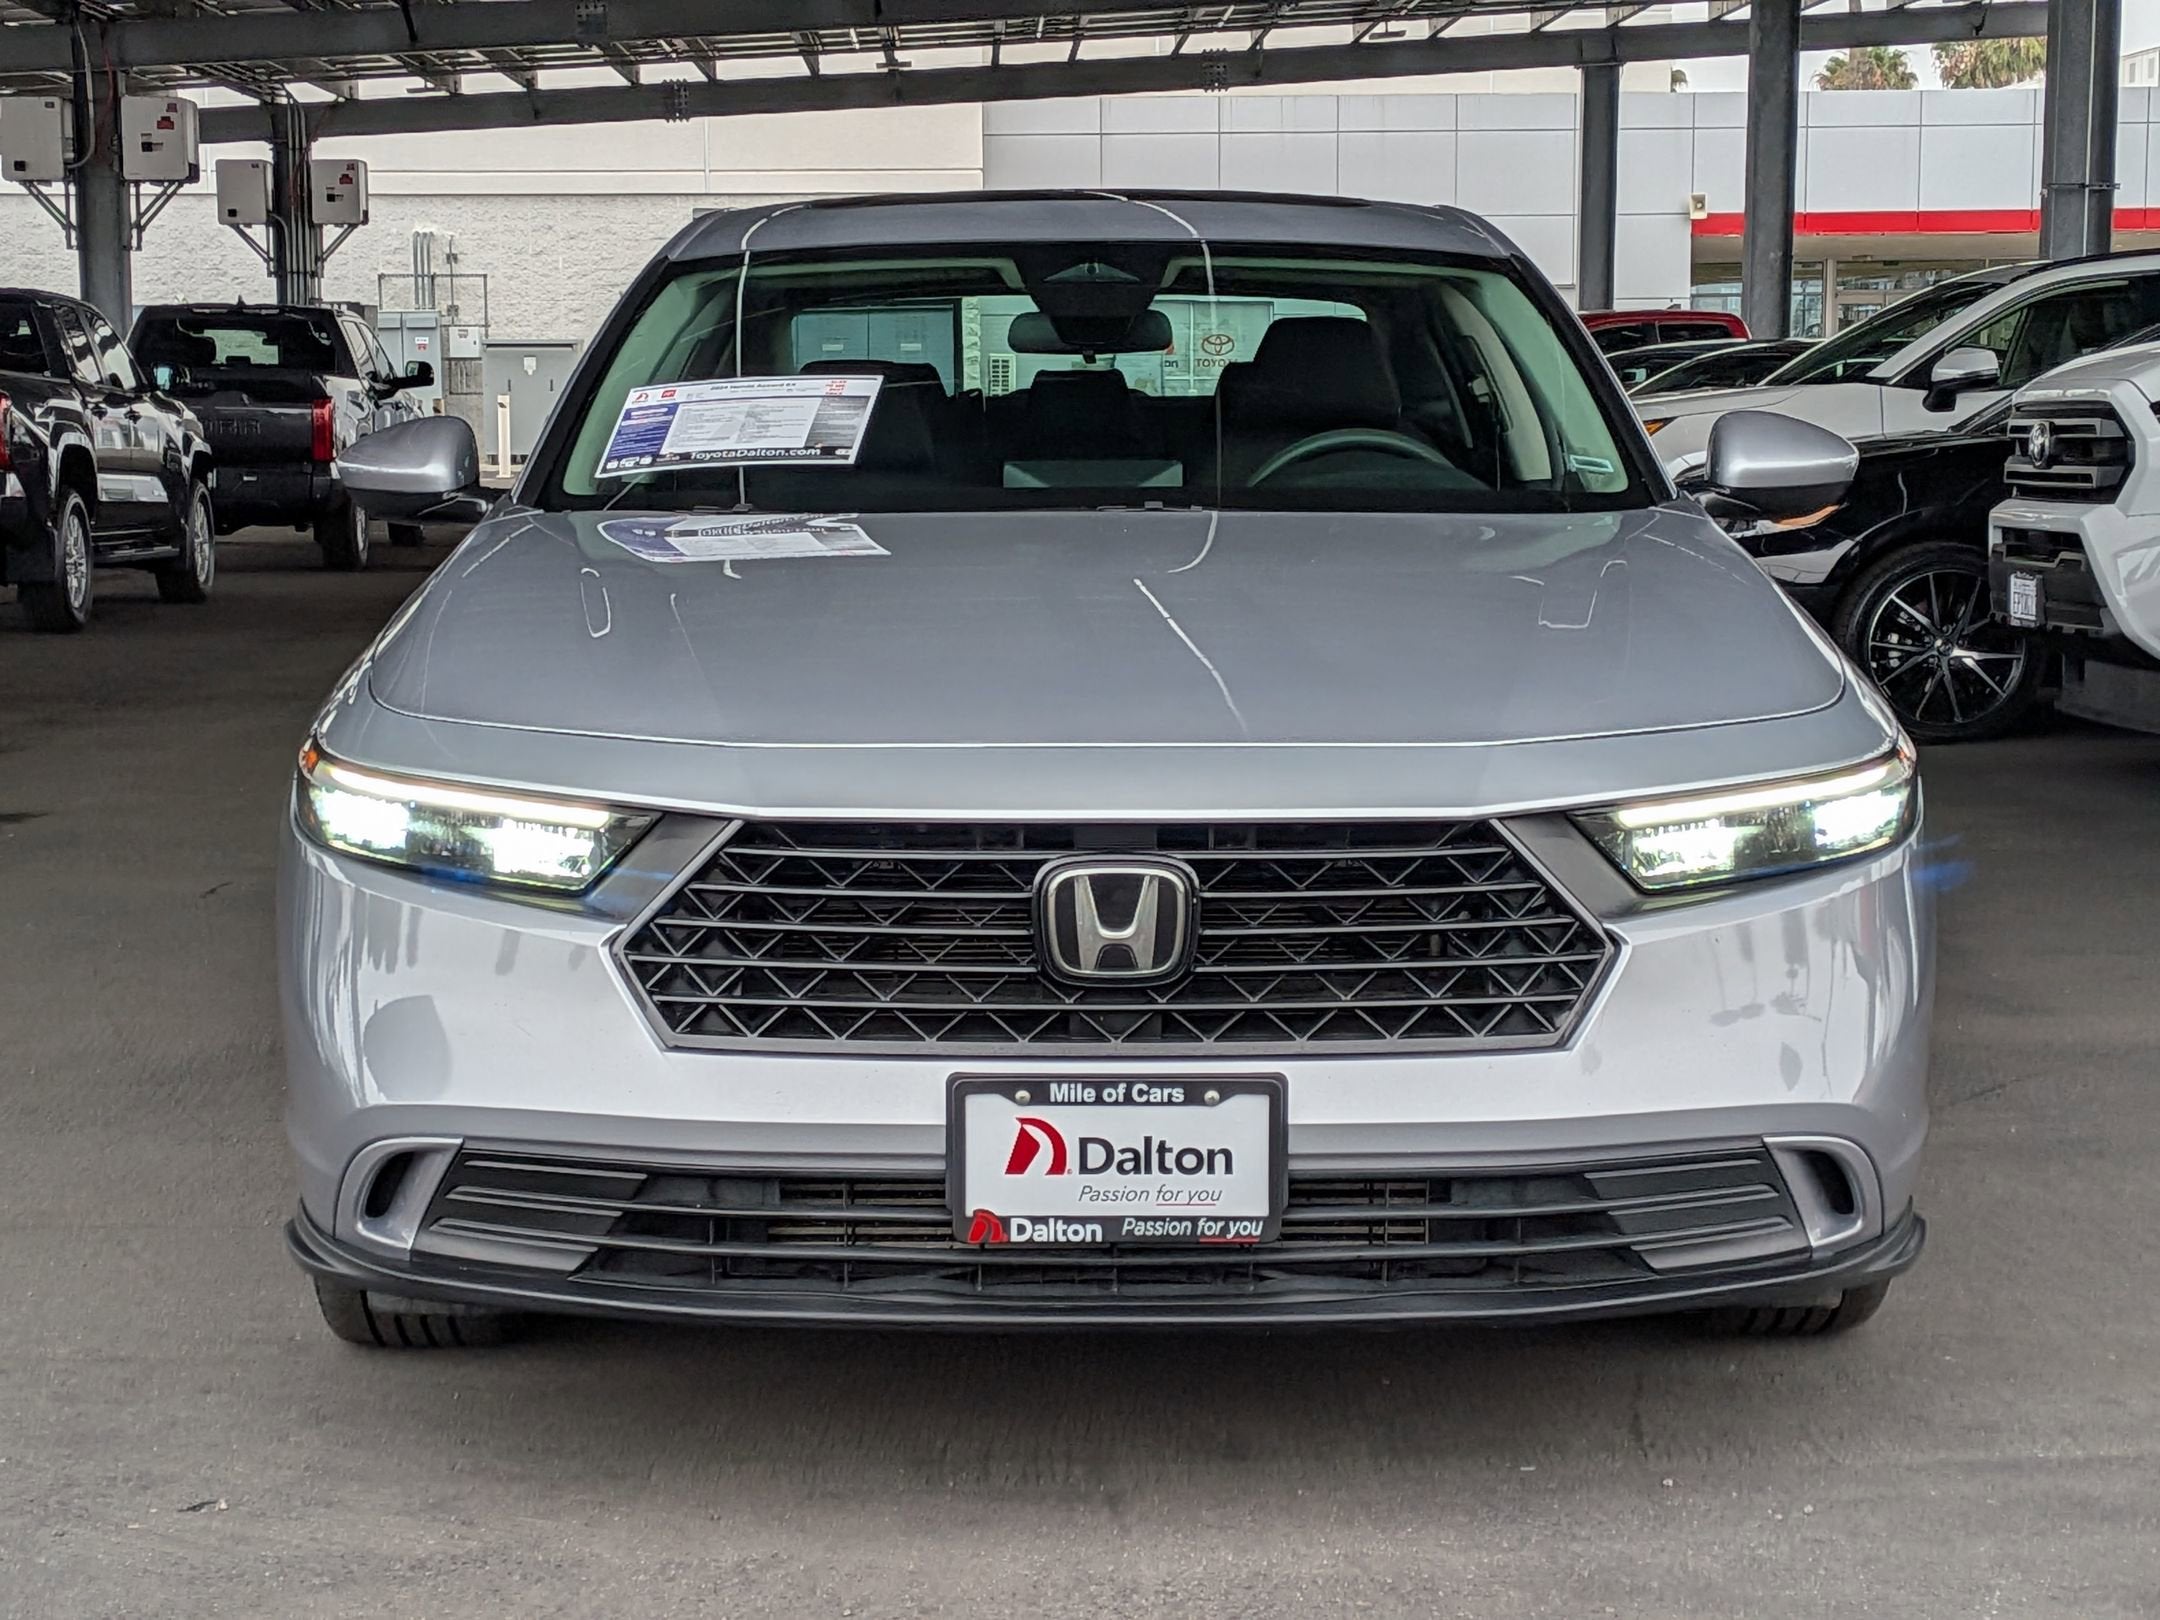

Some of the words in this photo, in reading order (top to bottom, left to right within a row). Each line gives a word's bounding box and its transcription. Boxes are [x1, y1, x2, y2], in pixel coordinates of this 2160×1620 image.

[690, 448, 821, 461] ToyotaDalton.com
[1050, 1082, 1097, 1103] Mile
[1102, 1082, 1127, 1103] of
[1131, 1082, 1185, 1103] Cars
[1078, 1135, 1234, 1176] Dalton
[1078, 1185, 1150, 1202] Passion
[1156, 1184, 1184, 1202] for
[1186, 1189, 1223, 1205] you
[1010, 1217, 1103, 1243] Dalton
[1121, 1217, 1192, 1237] Passion
[1195, 1217, 1225, 1237] for
[1225, 1220, 1263, 1240] you
